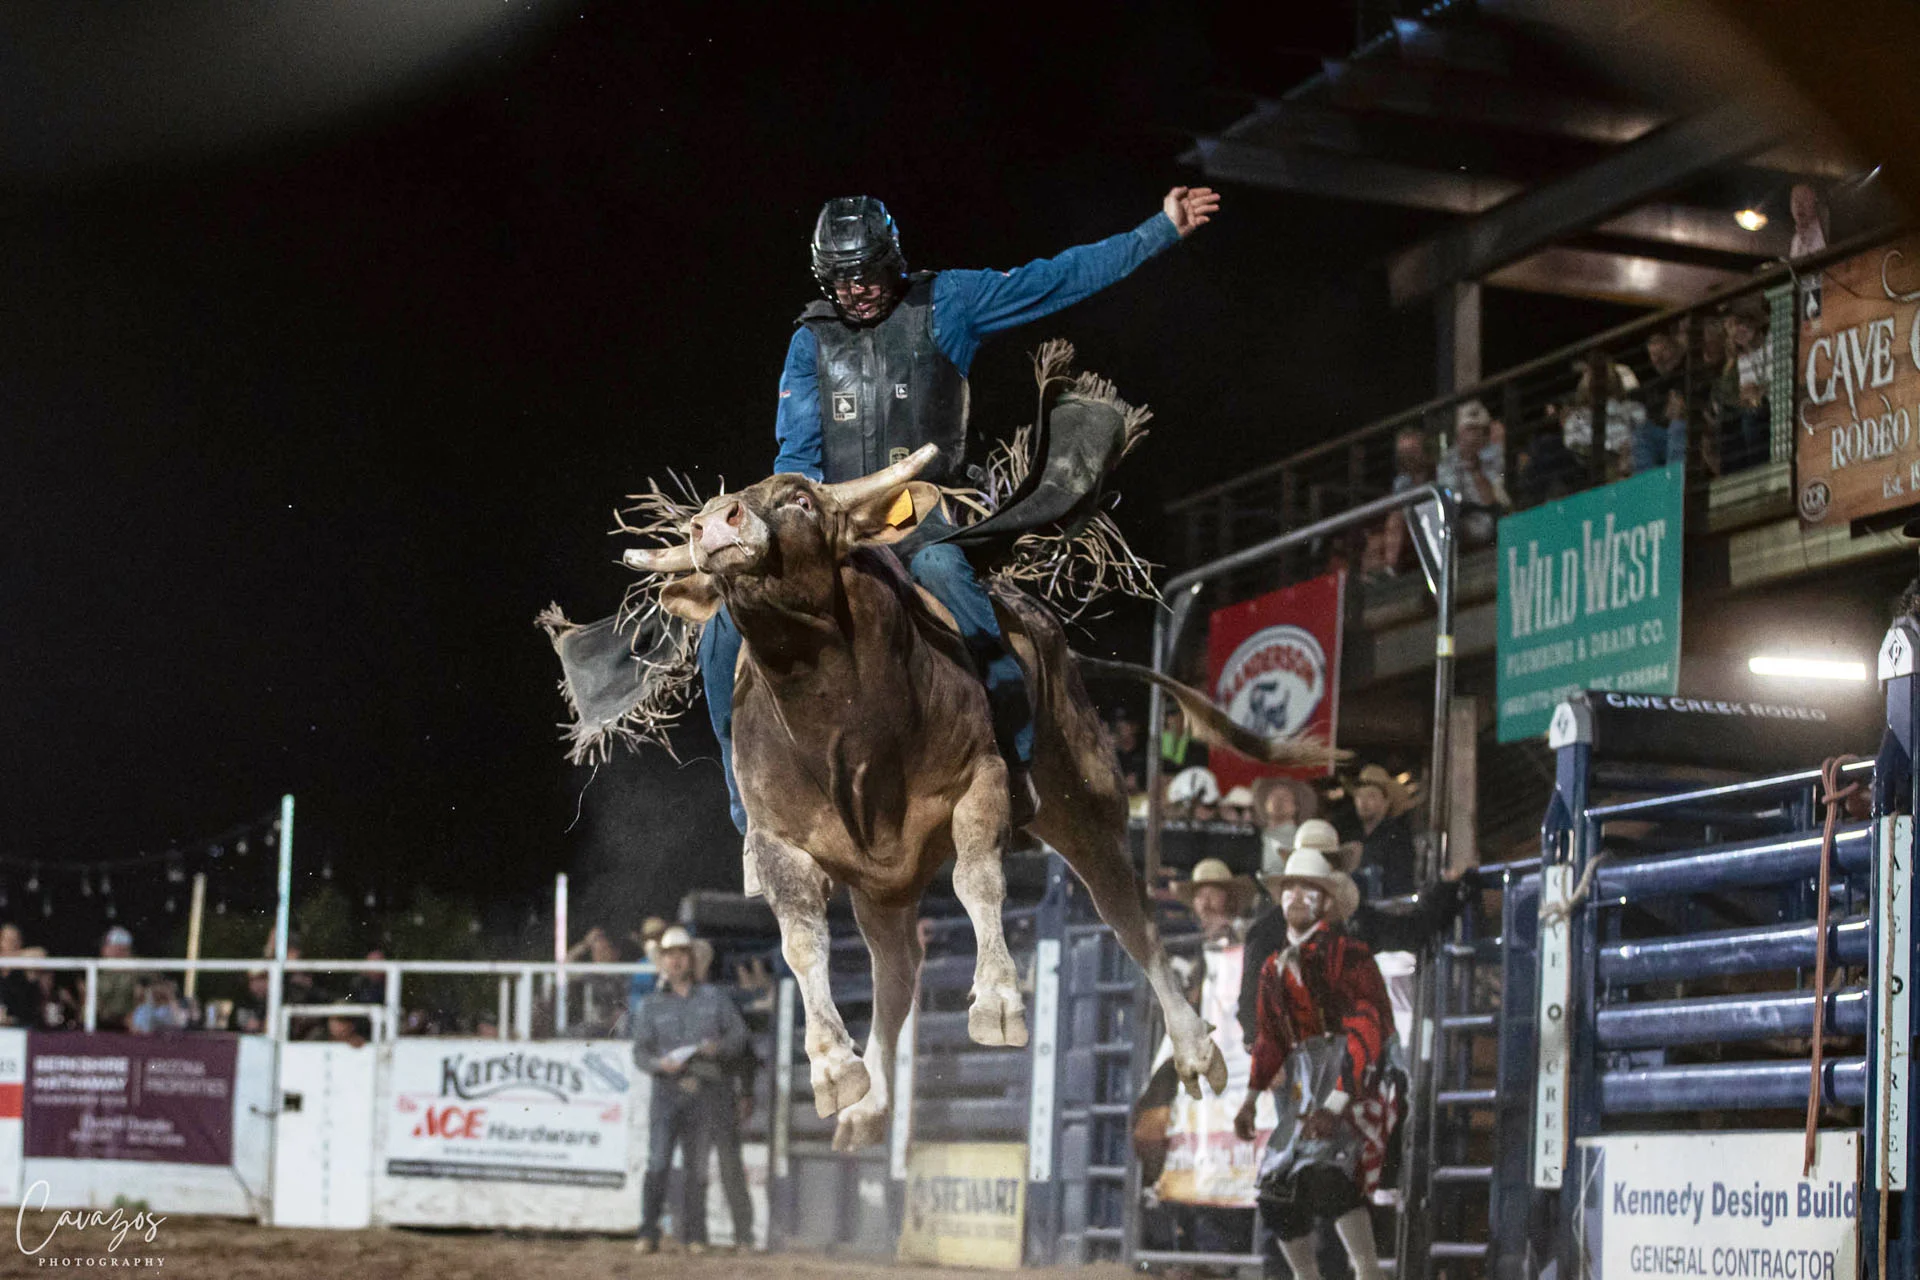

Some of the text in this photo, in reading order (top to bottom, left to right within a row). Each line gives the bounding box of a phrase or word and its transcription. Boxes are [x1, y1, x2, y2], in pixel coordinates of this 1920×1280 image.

[1806, 317, 1895, 416] CAVE
[1831, 408, 1910, 470] RODEO
[1508, 512, 1666, 638] WILD WEST
[1606, 692, 1668, 711] CAVE
[1669, 697, 1747, 717] CREEK
[1749, 703, 1826, 721] RODEO
[441, 1053, 583, 1100] Karsten's
[413, 1106, 601, 1146] ACE Hardware
[1613, 1180, 1857, 1227] Kennedy Design Build
[1631, 1244, 1836, 1280] GENERAL CONTRACTOR
